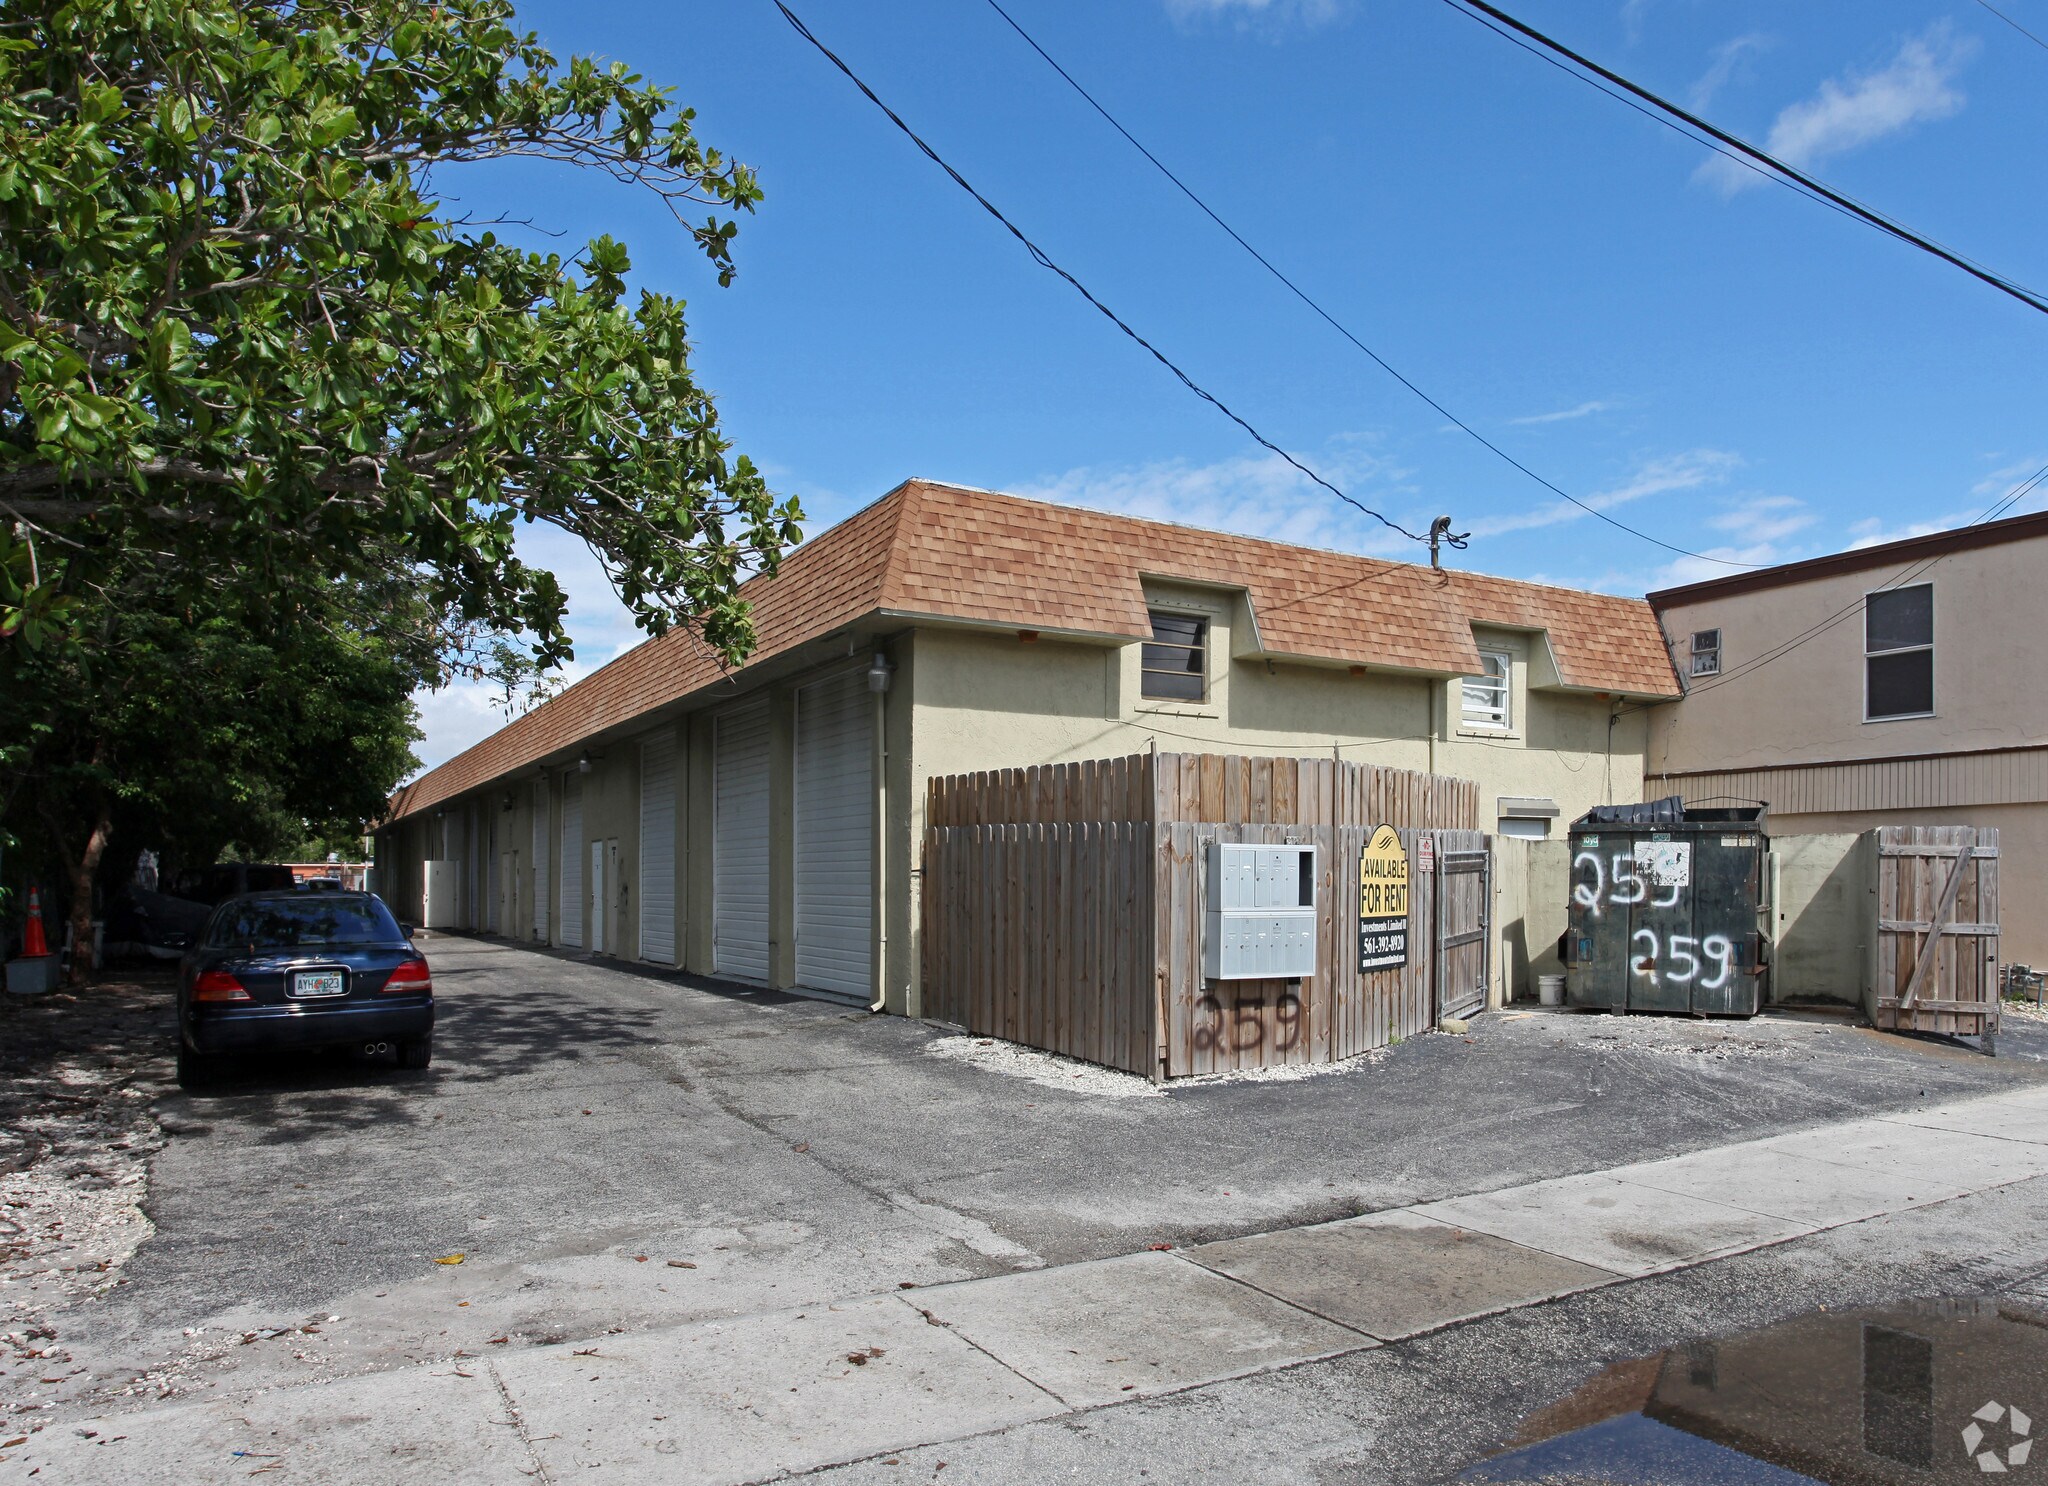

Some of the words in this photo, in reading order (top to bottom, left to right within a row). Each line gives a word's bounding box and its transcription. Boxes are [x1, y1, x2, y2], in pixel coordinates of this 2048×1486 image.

[1363, 858, 1405, 879] AVAILABLE
[1361, 883, 1381, 914] FOR
[1384, 883, 1407, 912] RENT
[1361, 921, 1387, 933] Investments
[1387, 919, 1402, 931] Limited
[1363, 934, 1405, 954] 561-392-8920
[1630, 929, 1731, 988] 259
[297, 978, 314, 990] AYH
[1193, 994, 1301, 1055] 259
